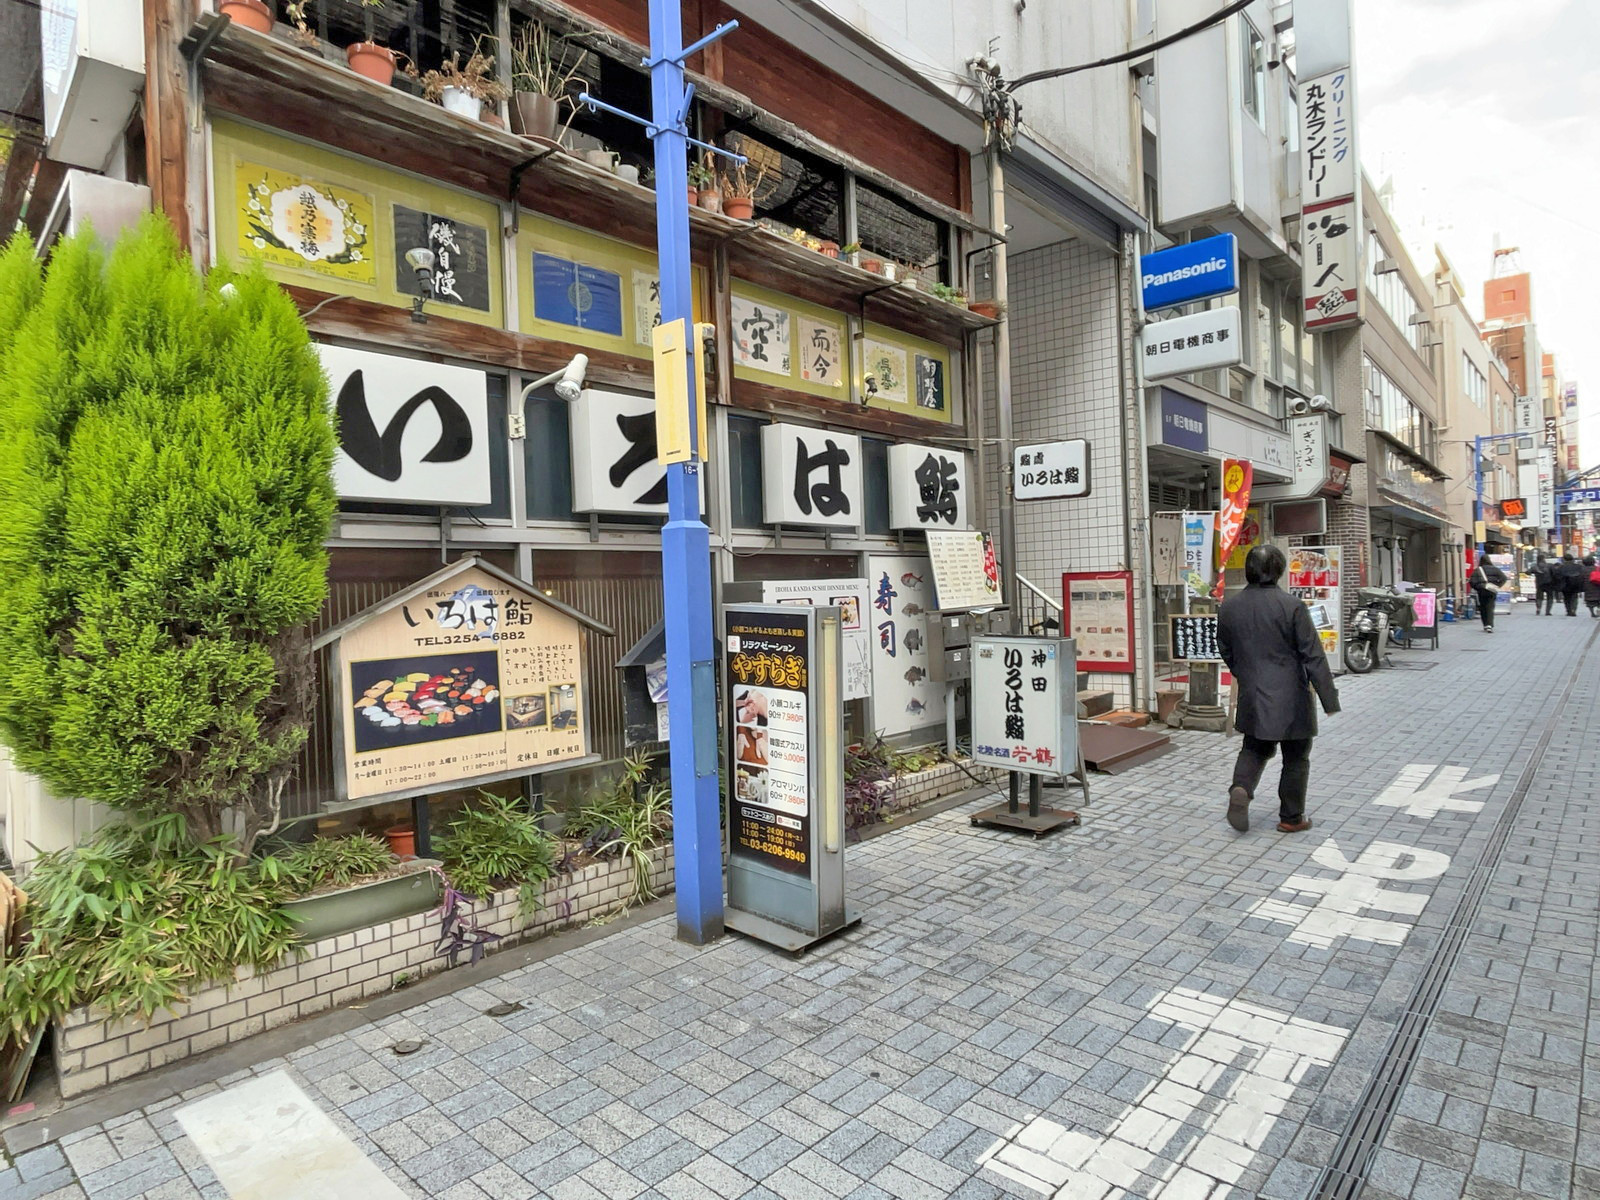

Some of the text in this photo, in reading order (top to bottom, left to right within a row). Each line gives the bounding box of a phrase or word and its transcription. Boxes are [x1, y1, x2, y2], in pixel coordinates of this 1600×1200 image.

[1331, 74, 1349, 164] クリーニング
[1306, 83, 1327, 198] 丸木ランドリー
[1143, 256, 1227, 290] Panasonic
[811, 328, 831, 379] 而今
[1145, 327, 1230, 357] 朝日電機商事
[1303, 429, 1315, 467] ぎょうざ
[793, 436, 851, 517] は
[914, 452, 960, 525] 鮨
[1020, 466, 1079, 488] いろは鮨
[793, 585, 812, 593] KANDA
[402, 597, 533, 630] いろは鮨
[874, 570, 899, 659] 寿司
[742, 640, 796, 653] リラクゼーション
[731, 651, 805, 689] やすらぎ
[1030, 648, 1048, 693] 神田
[770, 698, 802, 711] 小顔コルギ
[1004, 647, 1025, 741] いろは鮨
[768, 710, 782, 719] 90分
[516, 751, 539, 762] 定休日
[769, 750, 783, 759] 40分
[976, 744, 1010, 759] 北陸名酒
[769, 790, 783, 800] 60分
[749, 838, 806, 864] 03-6206-9949
